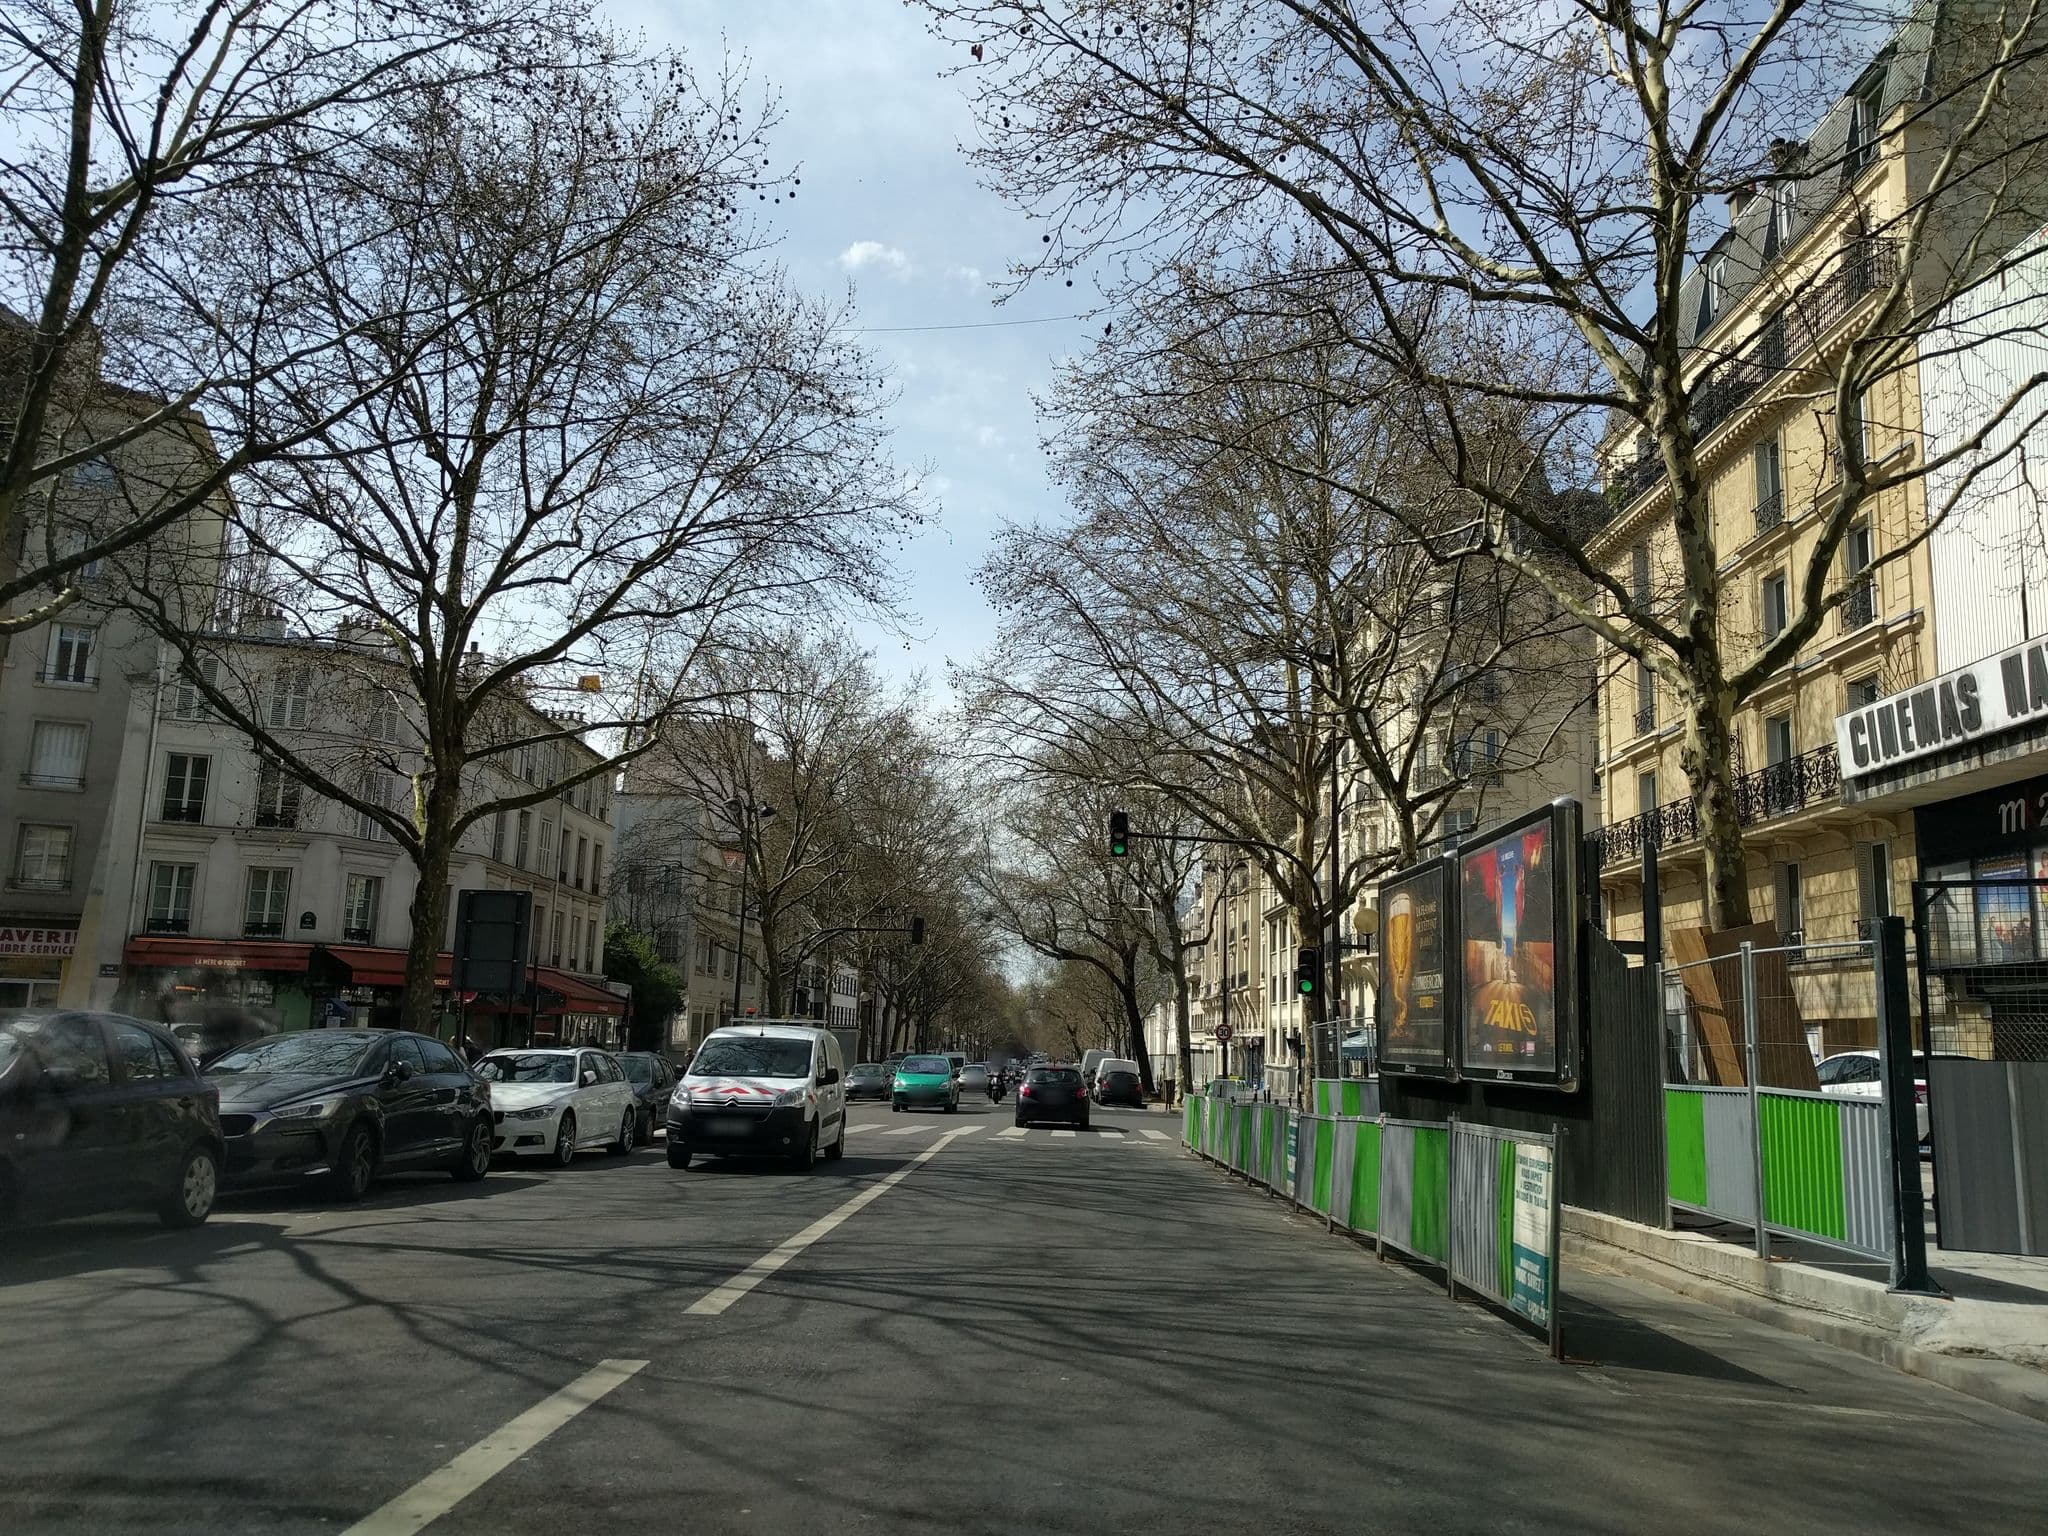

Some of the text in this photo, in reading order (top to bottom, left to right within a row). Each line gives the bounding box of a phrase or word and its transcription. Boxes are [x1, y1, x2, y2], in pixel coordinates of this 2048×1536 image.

[1849, 641, 2048, 768] CINEMAS NA
[0, 929, 78, 944] AVERI
[30, 944, 75, 955] SERVICE
[1484, 999, 1521, 1032] TAXI
